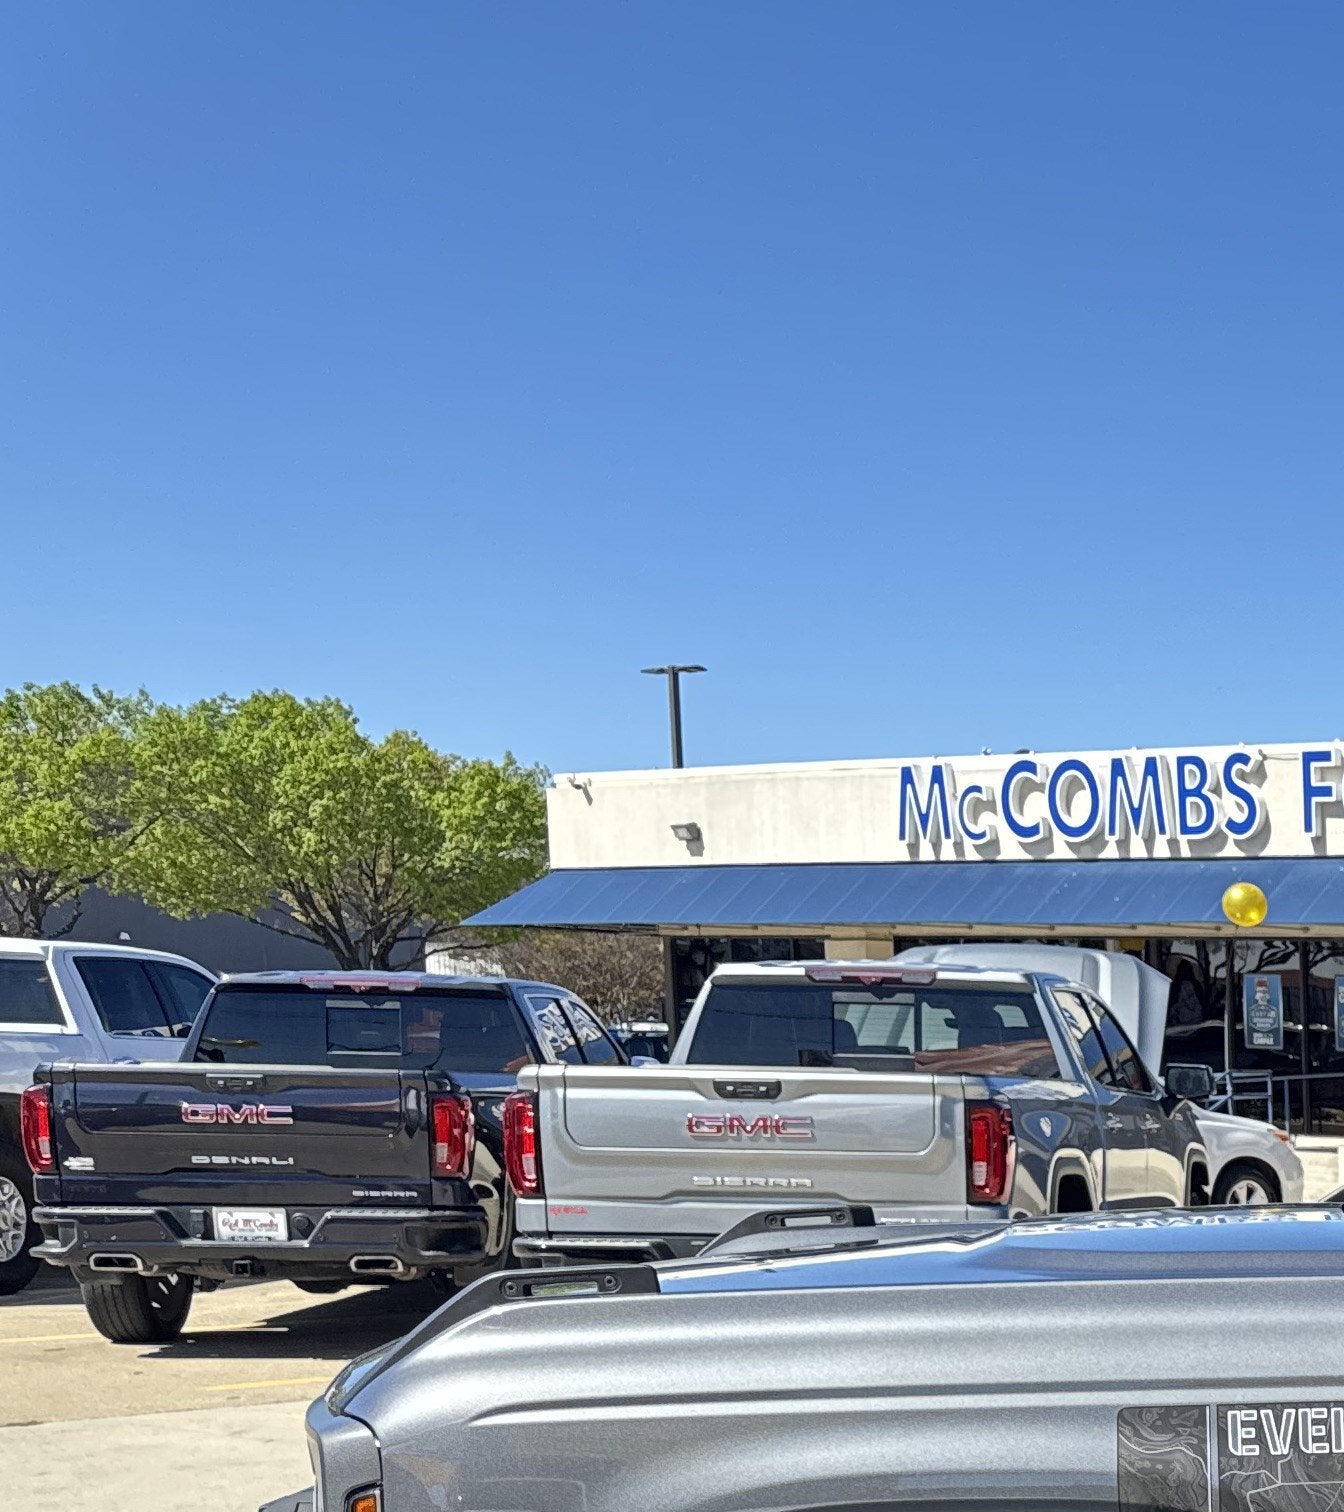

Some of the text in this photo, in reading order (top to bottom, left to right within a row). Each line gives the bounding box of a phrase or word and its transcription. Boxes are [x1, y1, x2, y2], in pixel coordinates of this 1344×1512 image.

[181, 1102, 294, 1125] GMC
[686, 1113, 814, 1138] GMC
[191, 1155, 294, 1166] DENALI
[692, 1176, 813, 1189] SIERRA
